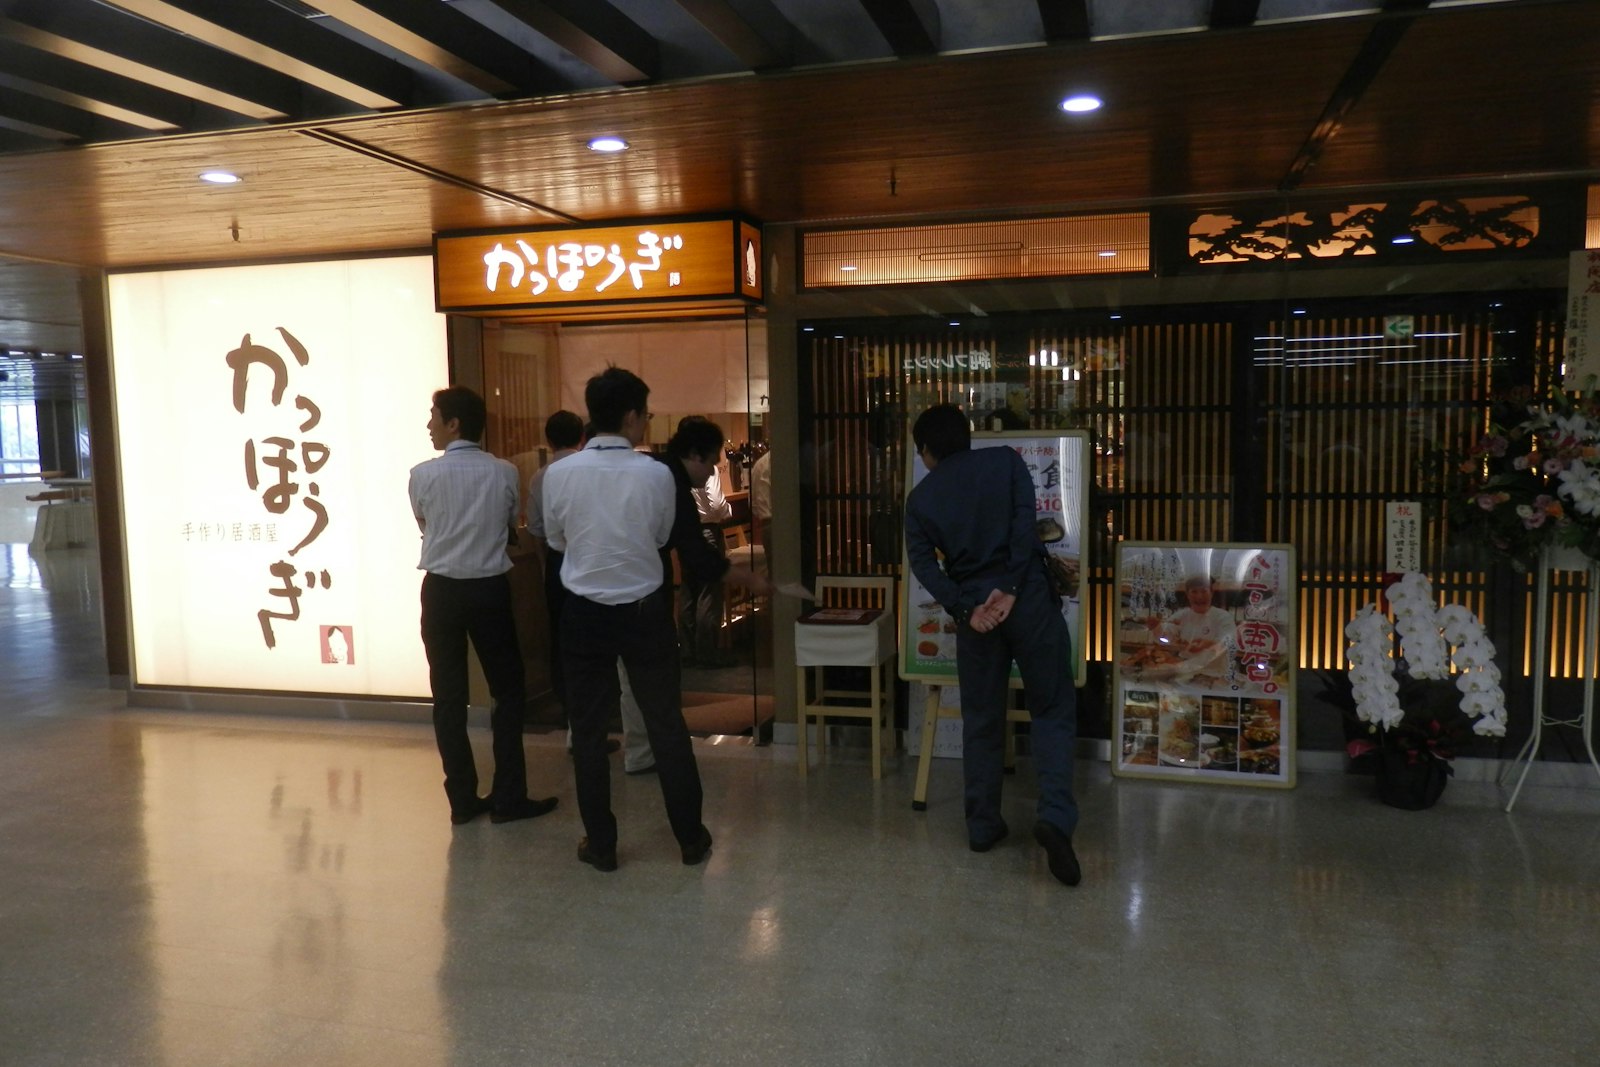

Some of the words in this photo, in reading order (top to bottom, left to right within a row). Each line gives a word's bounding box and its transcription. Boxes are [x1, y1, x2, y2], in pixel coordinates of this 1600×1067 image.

[484, 231, 683, 296] かっぽうぎ
[226, 327, 331, 650] かっぽうぎ
[181, 522, 278, 542] 手作り居酒屋
